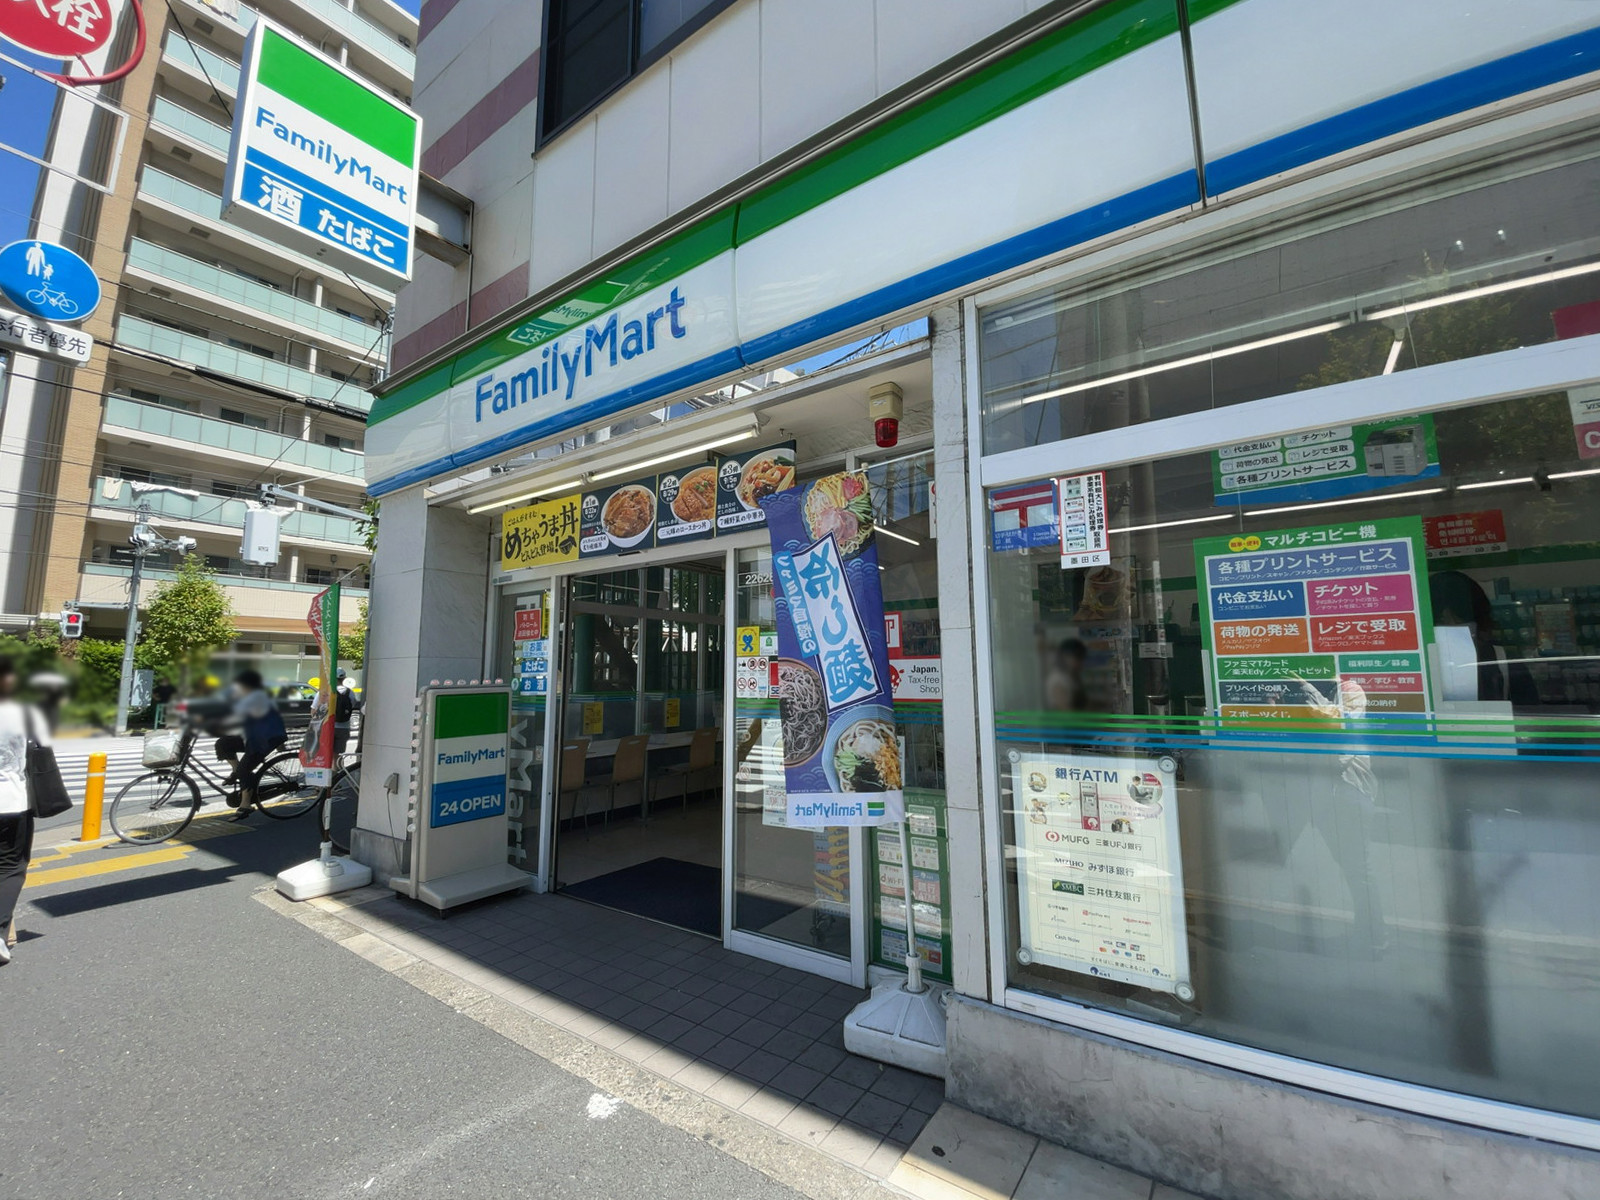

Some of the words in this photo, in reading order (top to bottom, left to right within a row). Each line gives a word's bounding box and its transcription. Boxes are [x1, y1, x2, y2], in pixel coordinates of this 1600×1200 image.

[255, 105, 408, 206] FamilyMart
[258, 174, 303, 225] 酒
[316, 207, 395, 264] たばこ
[474, 286, 687, 424] FamilyMart
[1301, 430, 1337, 443] チケット
[1234, 440, 1276, 454] 代金支払い
[1302, 444, 1349, 458] レジで受取
[1236, 455, 1278, 469] 荷物の発送
[1236, 459, 1351, 485] 各種プリントサービス
[504, 501, 579, 560] めちゃうま丼
[1264, 524, 1377, 546] マルチコピー機
[1217, 547, 1397, 575] 各種プリントサービス
[1217, 589, 1294, 605] 代金支払い
[1314, 581, 1379, 598] チケット
[1219, 623, 1300, 639] 荷物の発送
[1318, 618, 1407, 635] レジで受取
[525, 661, 545, 673] たばこ
[911, 665, 940, 675] Japan.
[1223, 659, 1290, 668] ファミマTカード
[908, 675, 940, 684] Tax-free
[920, 684, 941, 695] Shop
[437, 746, 506, 767] FamilyMart
[1055, 767, 1119, 784] 銀行ATM
[1061, 834, 1090, 845] MUFG
[1095, 838, 1142, 852] 三菱UFJ銀行
[1088, 862, 1135, 878] みずほ銀行
[1087, 886, 1141, 903] 三井住友銀行
